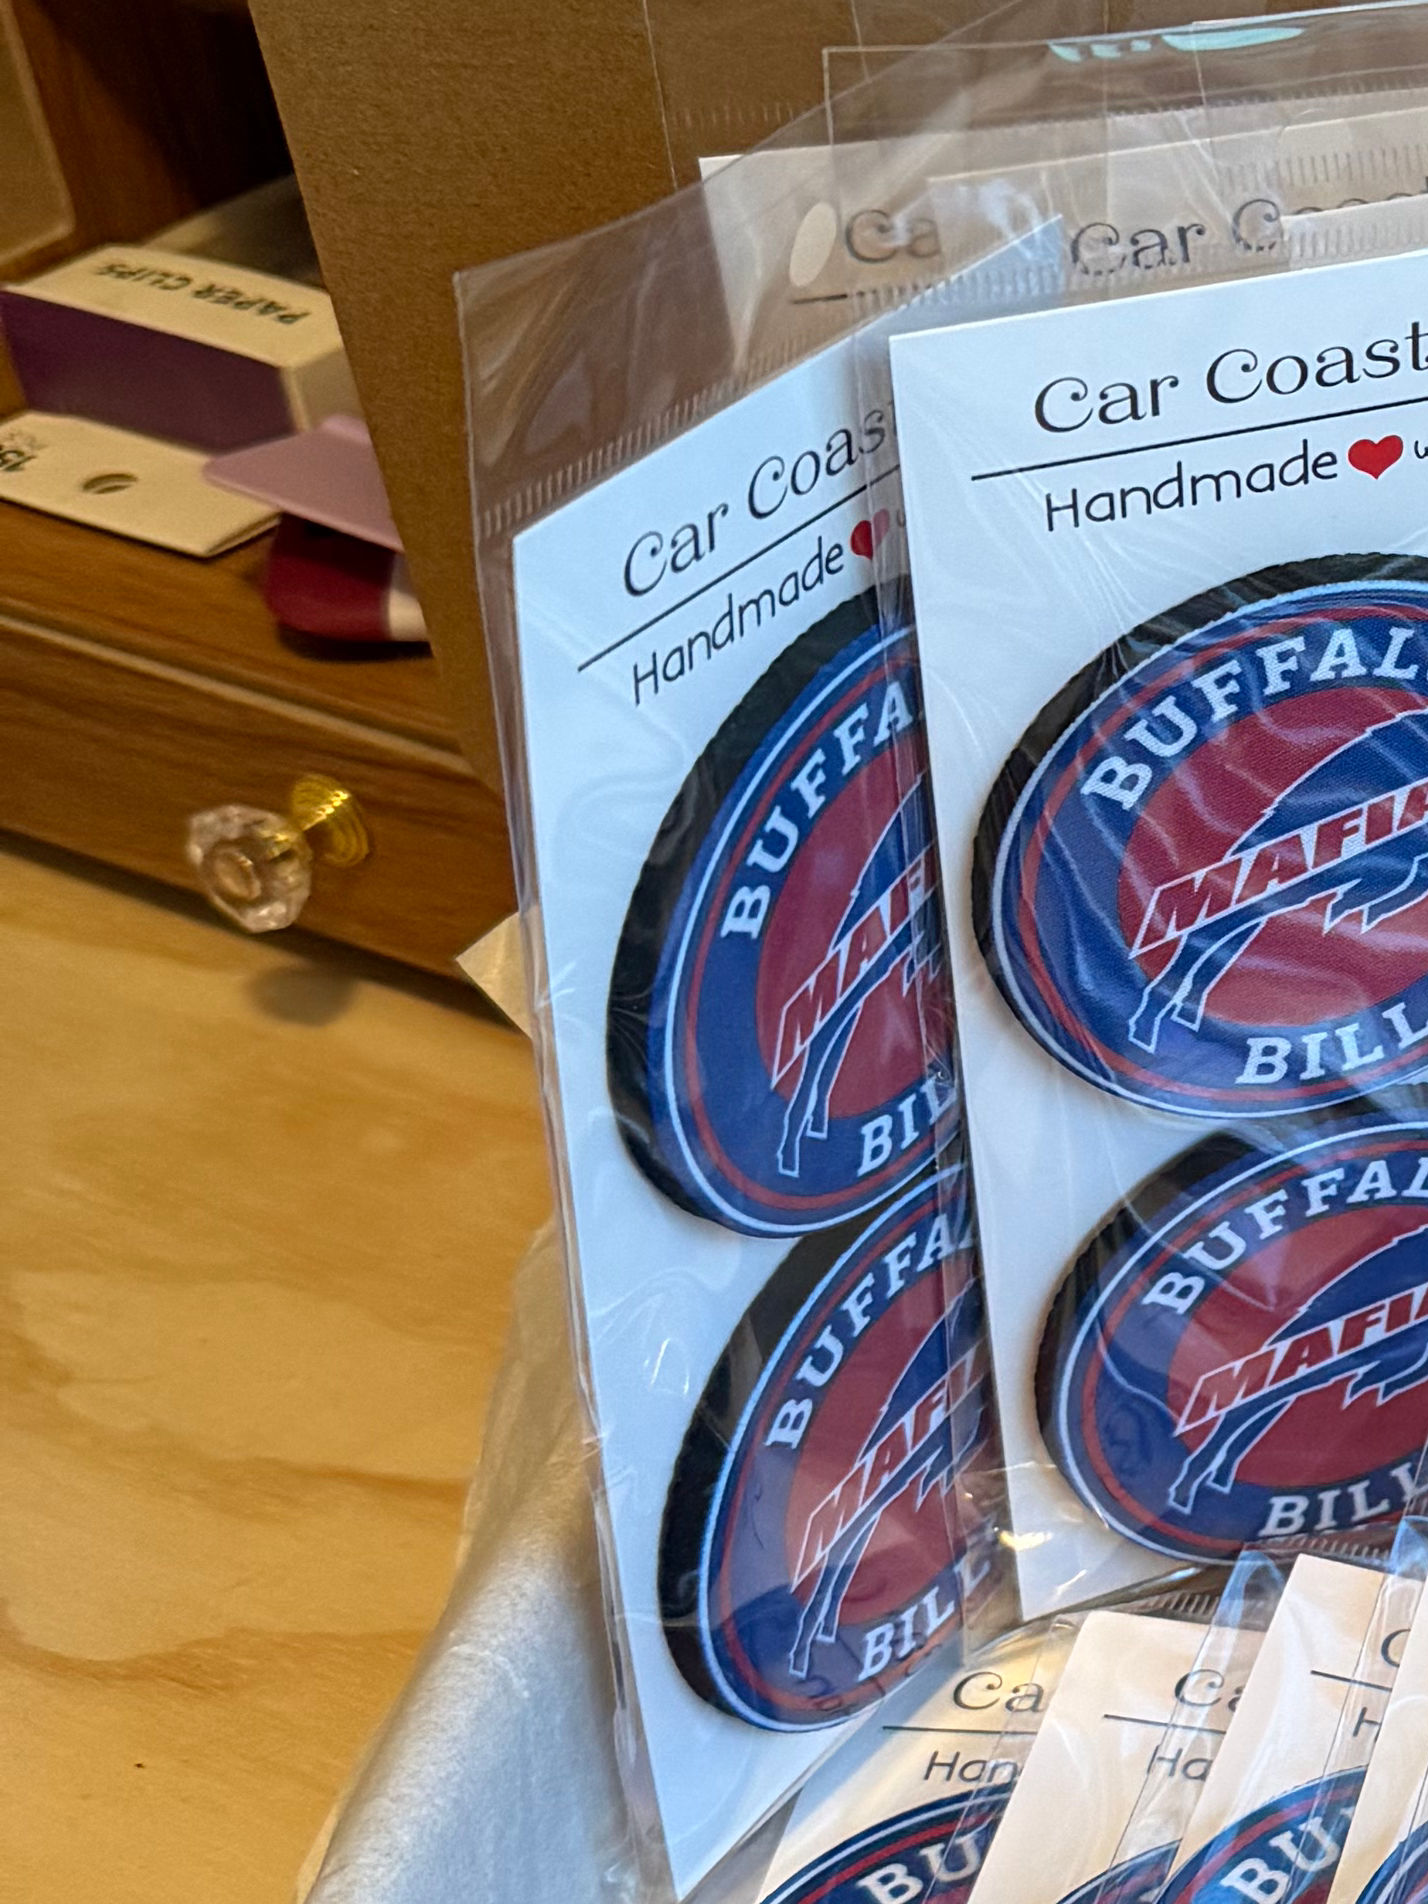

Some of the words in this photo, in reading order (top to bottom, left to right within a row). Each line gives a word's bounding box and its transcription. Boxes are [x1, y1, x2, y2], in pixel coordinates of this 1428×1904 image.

[97, 263, 193, 291] CLIPS
[1071, 219, 1206, 277] Car
[193, 283, 310, 324] PAPER
[1034, 373, 1179, 434] Car
[623, 501, 729, 597] Car
[748, 410, 888, 519] Coas
[1045, 439, 1338, 533] Handmade
[632, 535, 845, 708] Handmade
[720, 680, 915, 940] BUFFA
[858, 1077, 958, 1177] BIL
[764, 1211, 973, 1452] BUFFA
[952, 1670, 1045, 1714] Ca
